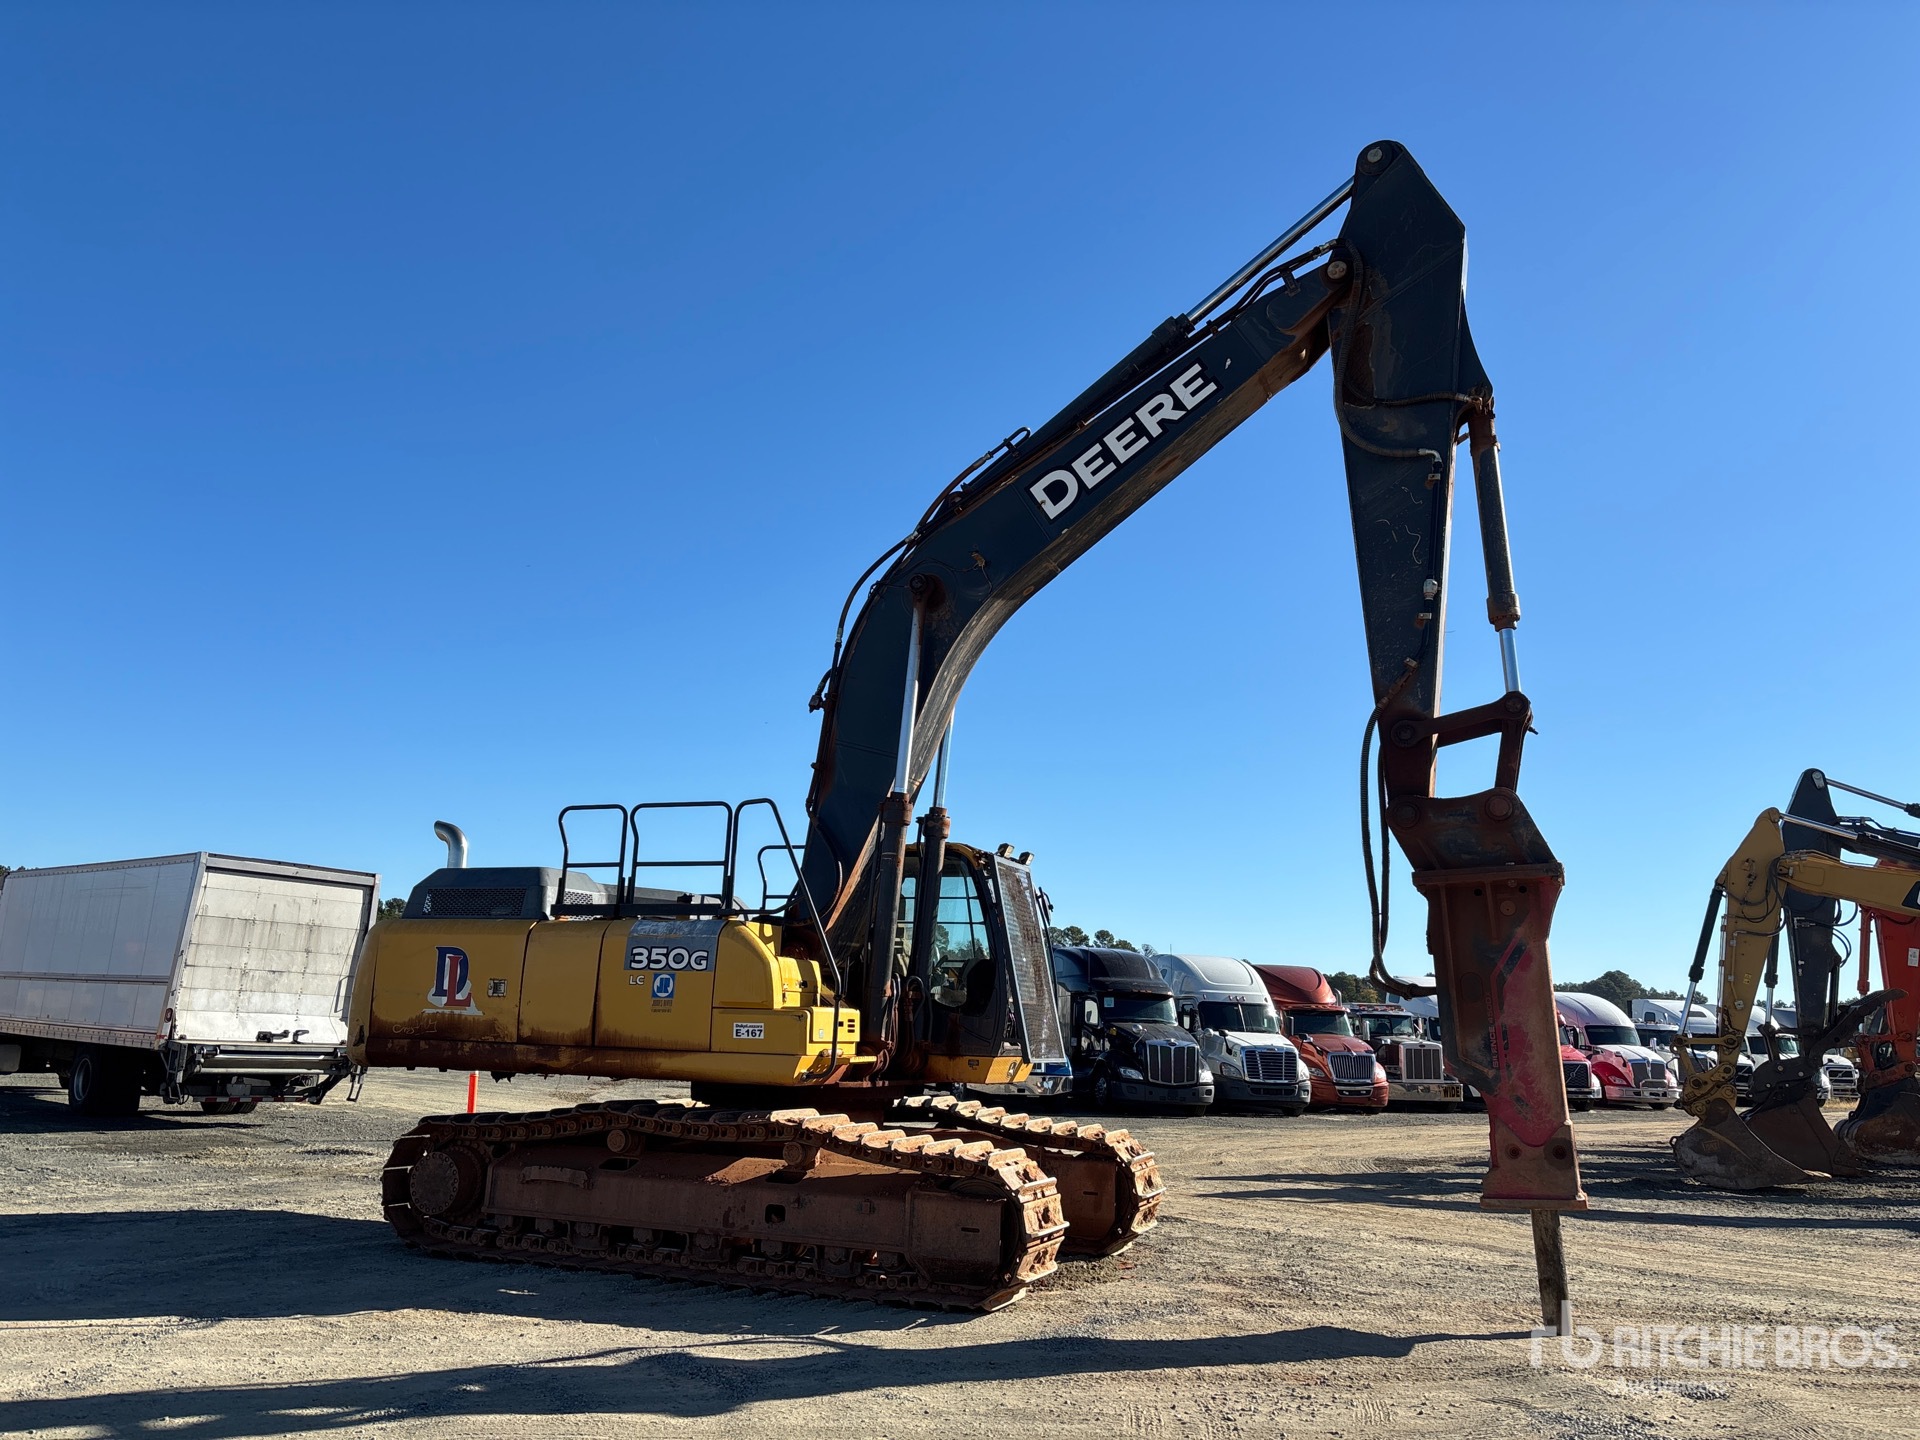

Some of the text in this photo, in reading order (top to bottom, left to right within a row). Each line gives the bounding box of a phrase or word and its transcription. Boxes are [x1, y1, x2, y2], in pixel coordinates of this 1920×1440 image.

[1030, 363, 1217, 520] DEERE
[630, 947, 708, 970] 350G
[629, 975, 645, 985] LC
[735, 1029, 763, 1037] E-167
